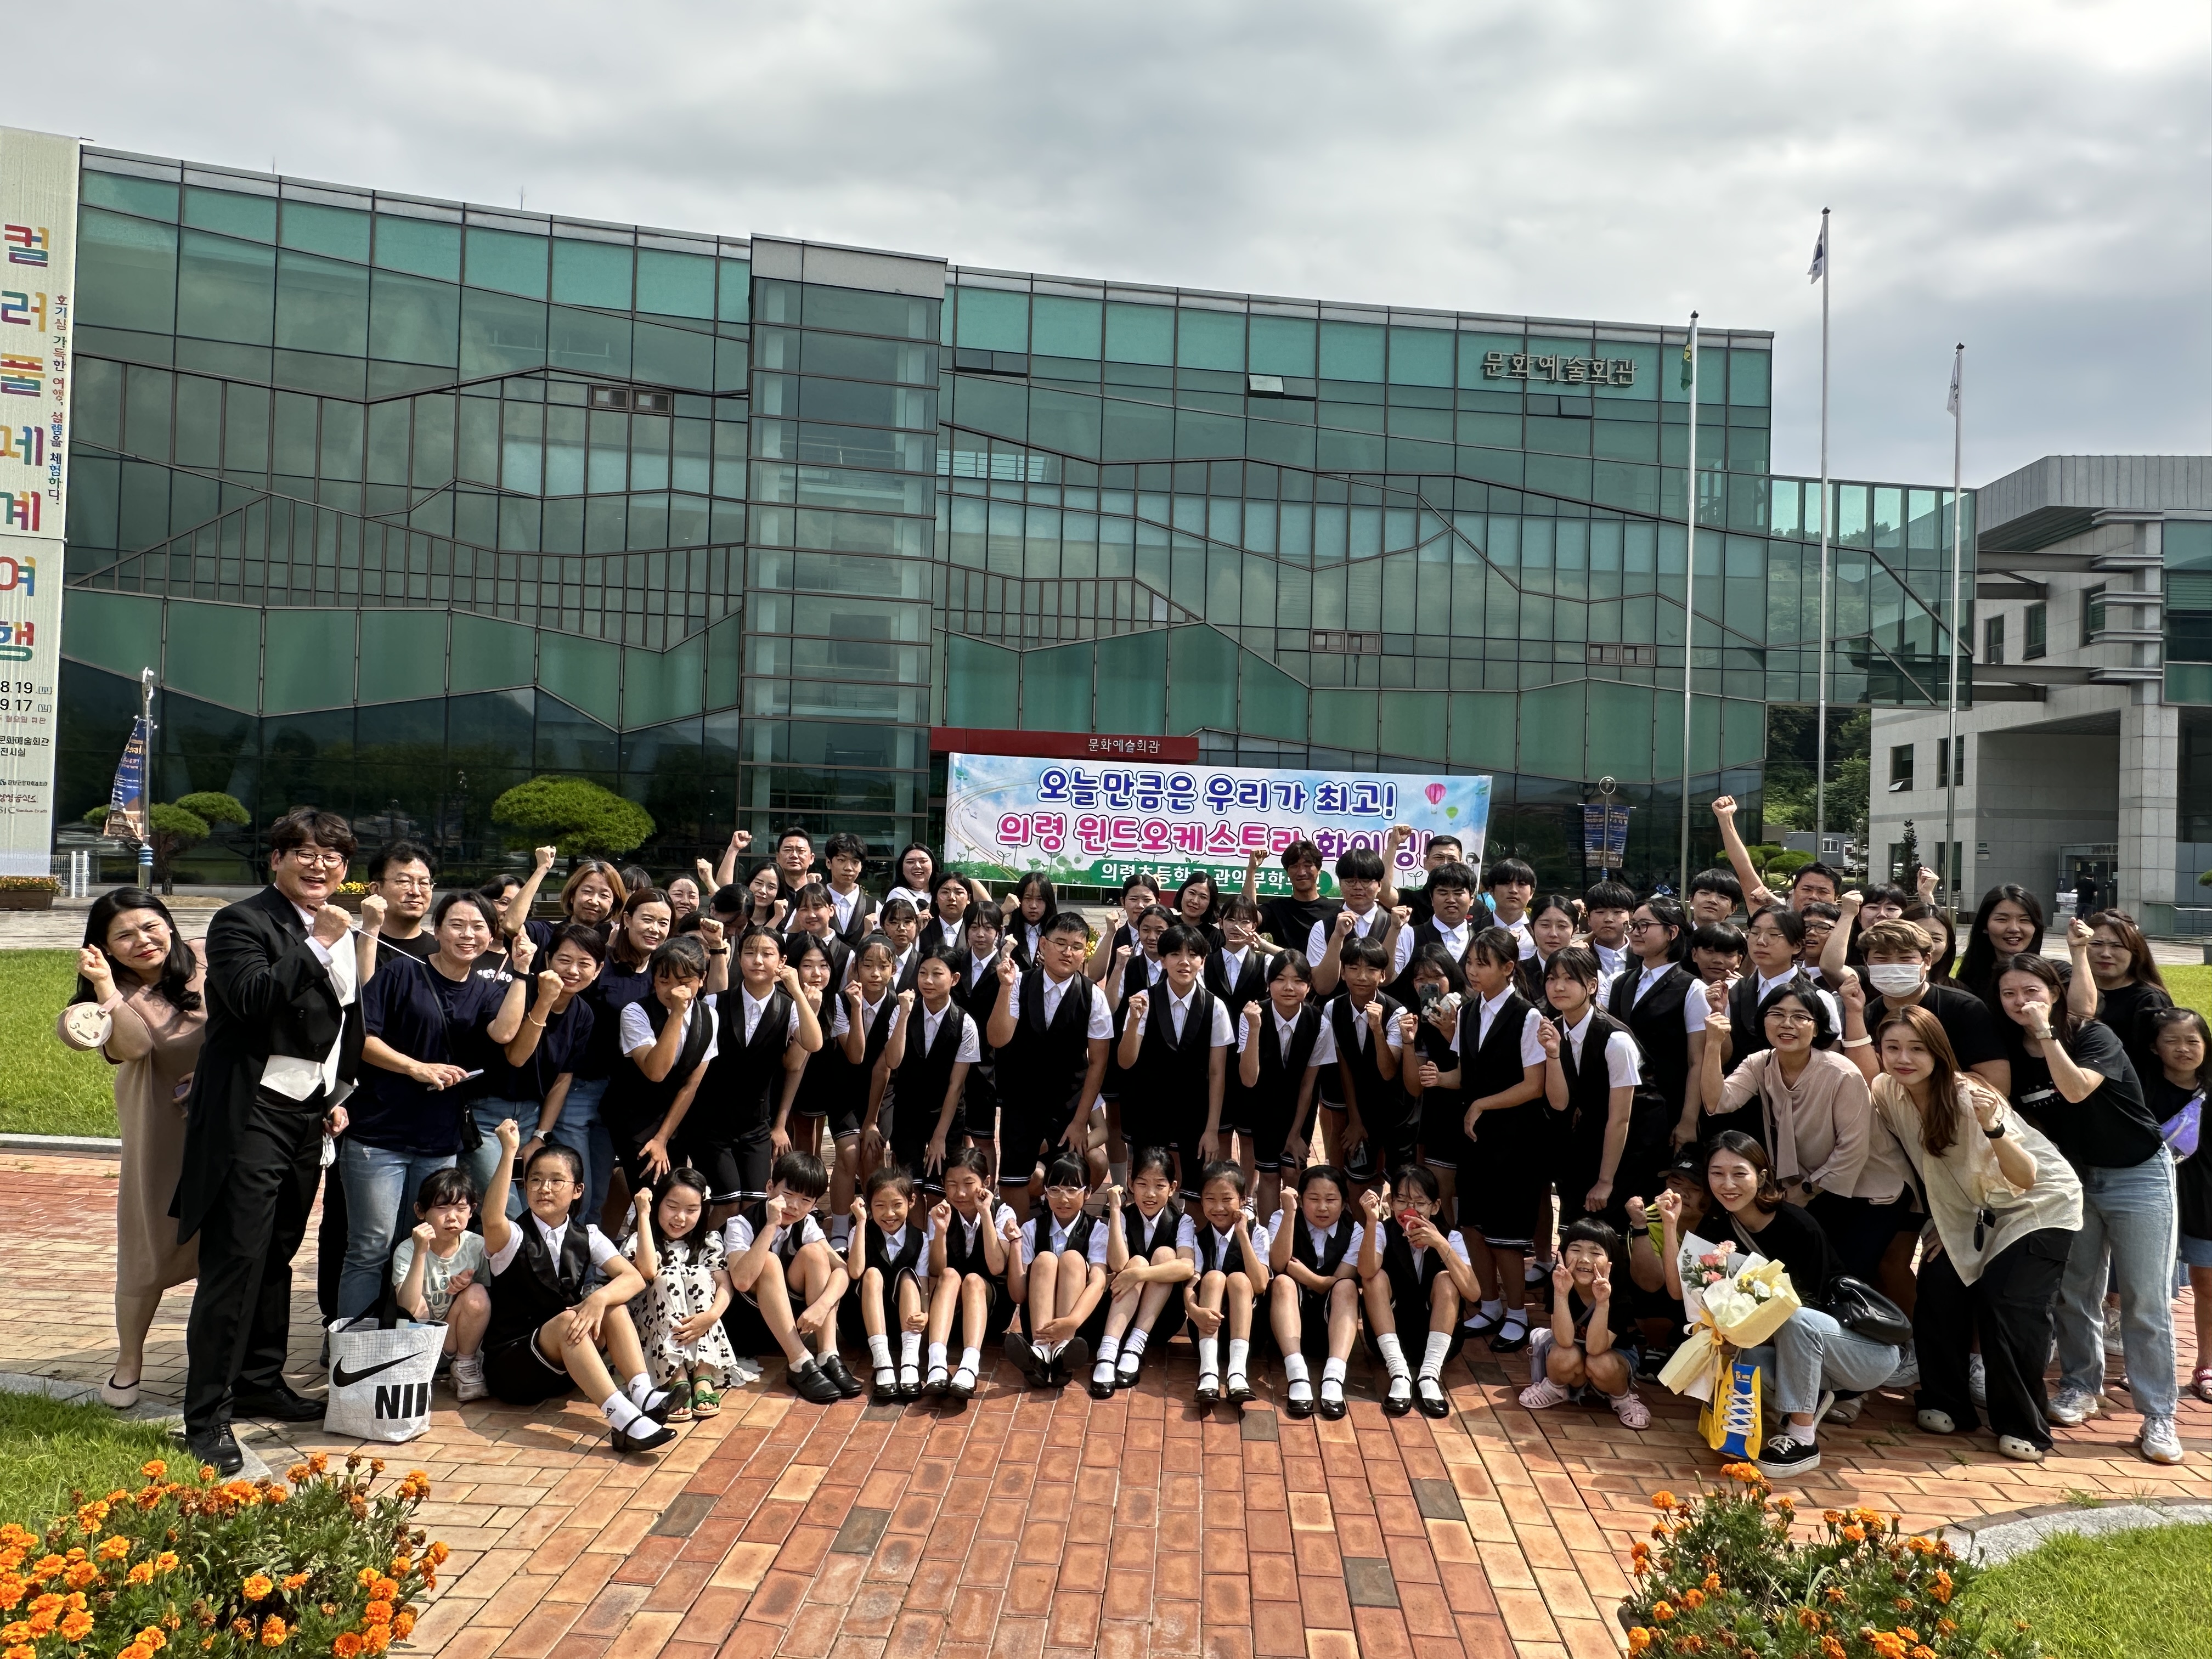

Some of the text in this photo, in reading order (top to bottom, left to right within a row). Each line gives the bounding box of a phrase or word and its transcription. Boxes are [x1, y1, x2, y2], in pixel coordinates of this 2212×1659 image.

[55, 295, 67, 331] 호기심
[53, 336, 67, 372] 가득한
[1482, 351, 1639, 385] 문화예술회관
[1088, 738, 1160, 754] 문화예술회관
[1039, 768, 1397, 819] 오늘만큼은 우리가 최고!
[997, 813, 1066, 851] 의령
[1075, 815, 1304, 860] 윈드오케스트라
